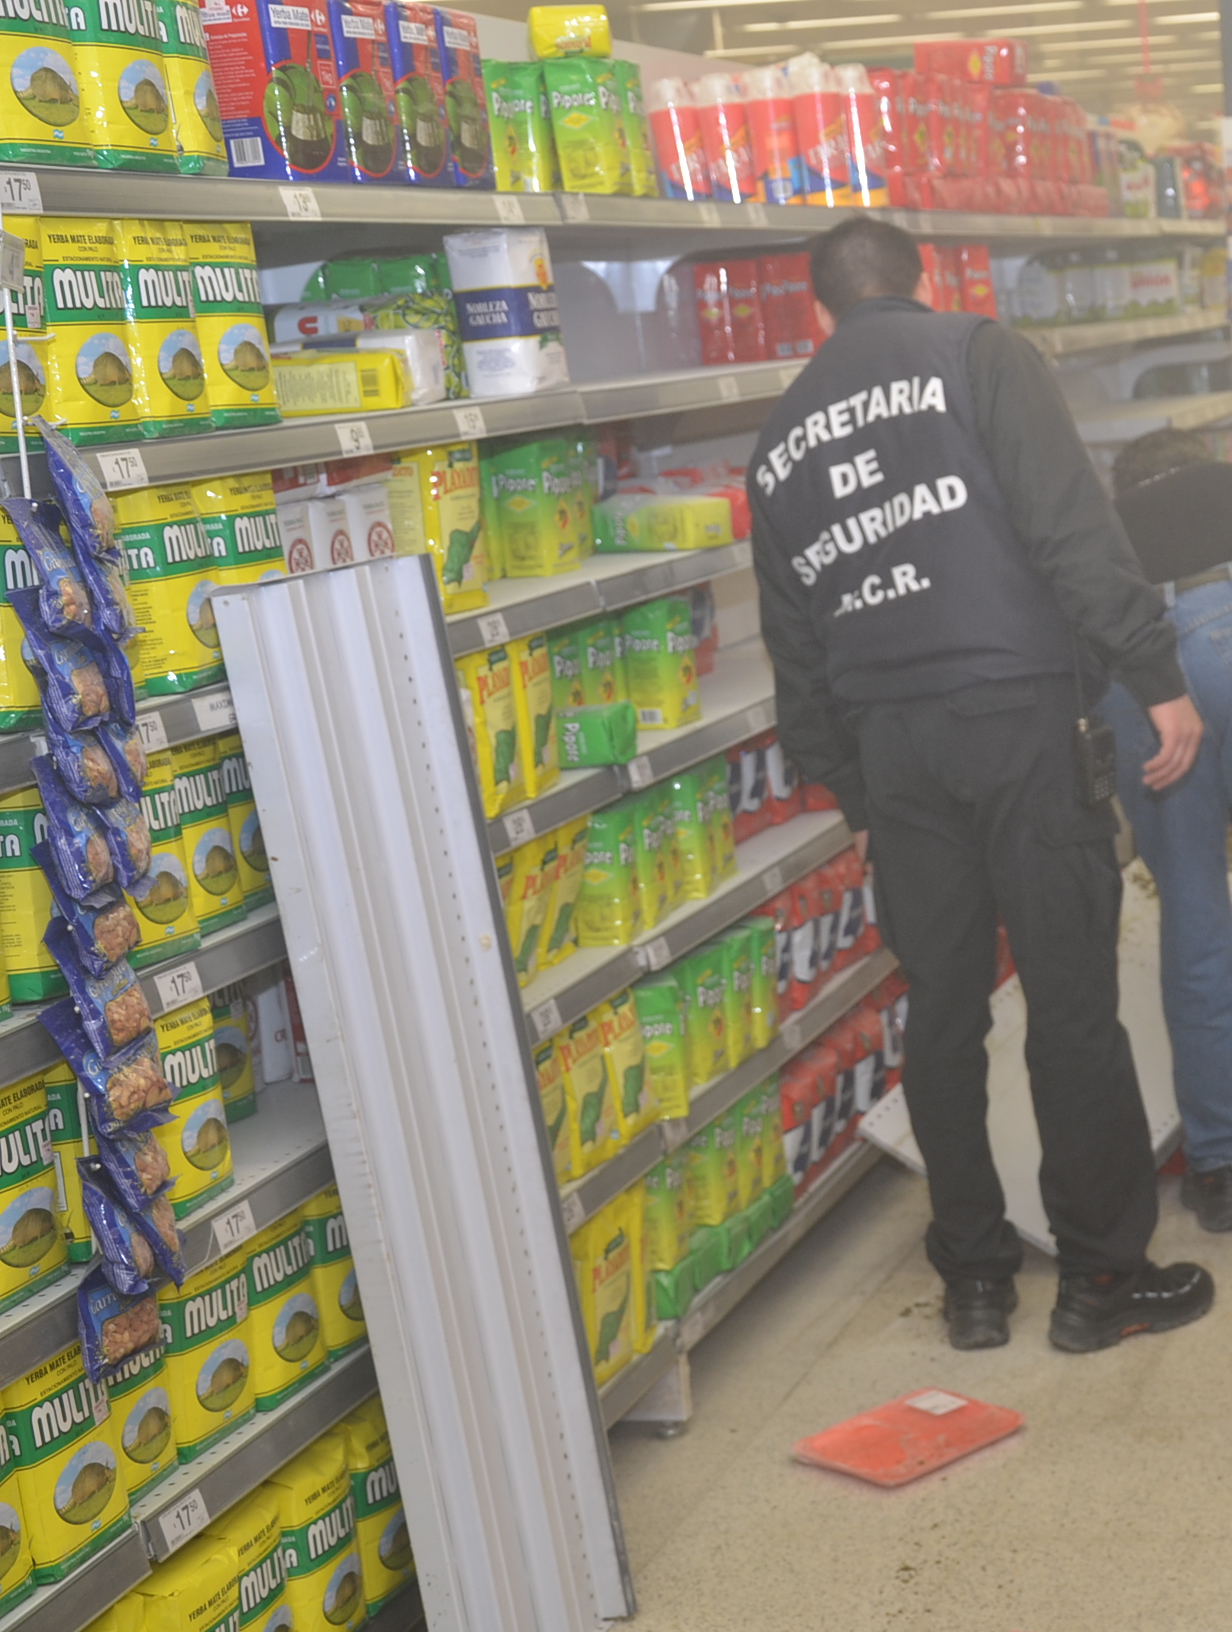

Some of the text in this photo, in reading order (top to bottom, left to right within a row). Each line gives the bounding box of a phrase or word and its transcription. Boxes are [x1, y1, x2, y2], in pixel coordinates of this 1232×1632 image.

[47, 233, 69, 245] YERBA
[70, 234, 88, 245] MATE
[190, 234, 211, 244] YERBA
[755, 375, 947, 497] SECRETARIA
[828, 448, 885, 500] DE
[160, 1019, 180, 1033] YERBA
[25, 1366, 49, 1386] YERBA
[49, 1355, 67, 1374] MATE
[188, 1605, 208, 1622] YERBA
[207, 1593, 222, 1608] MATE
